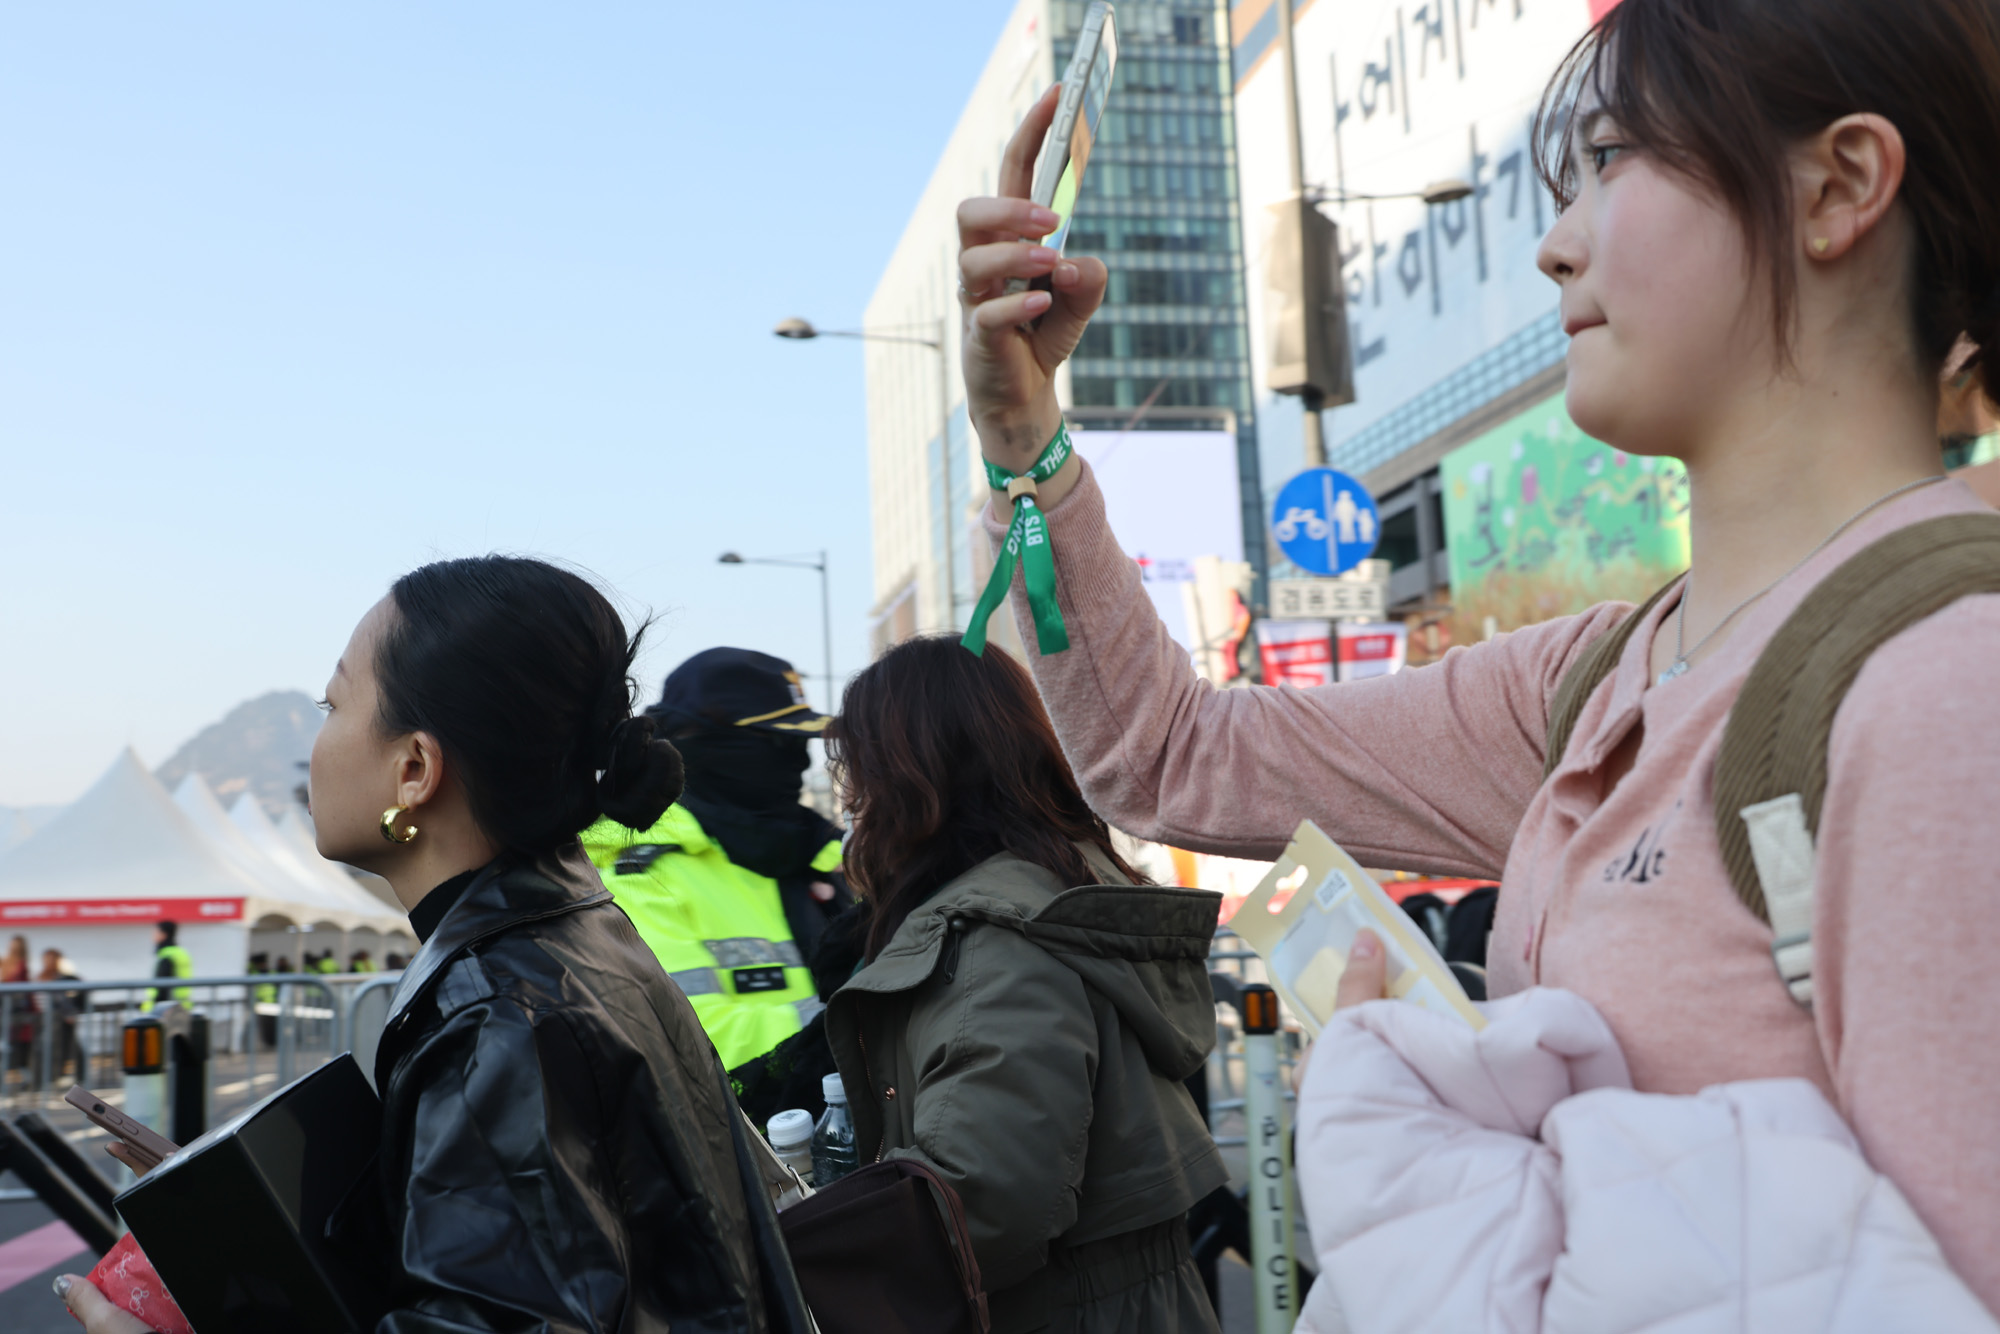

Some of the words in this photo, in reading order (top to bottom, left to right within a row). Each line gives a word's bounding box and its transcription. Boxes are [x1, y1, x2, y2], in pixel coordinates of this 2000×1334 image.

[1039, 441, 1067, 474] THE
[1024, 515, 1044, 546] BTS
[1260, 1116, 1291, 1311] POLICE
